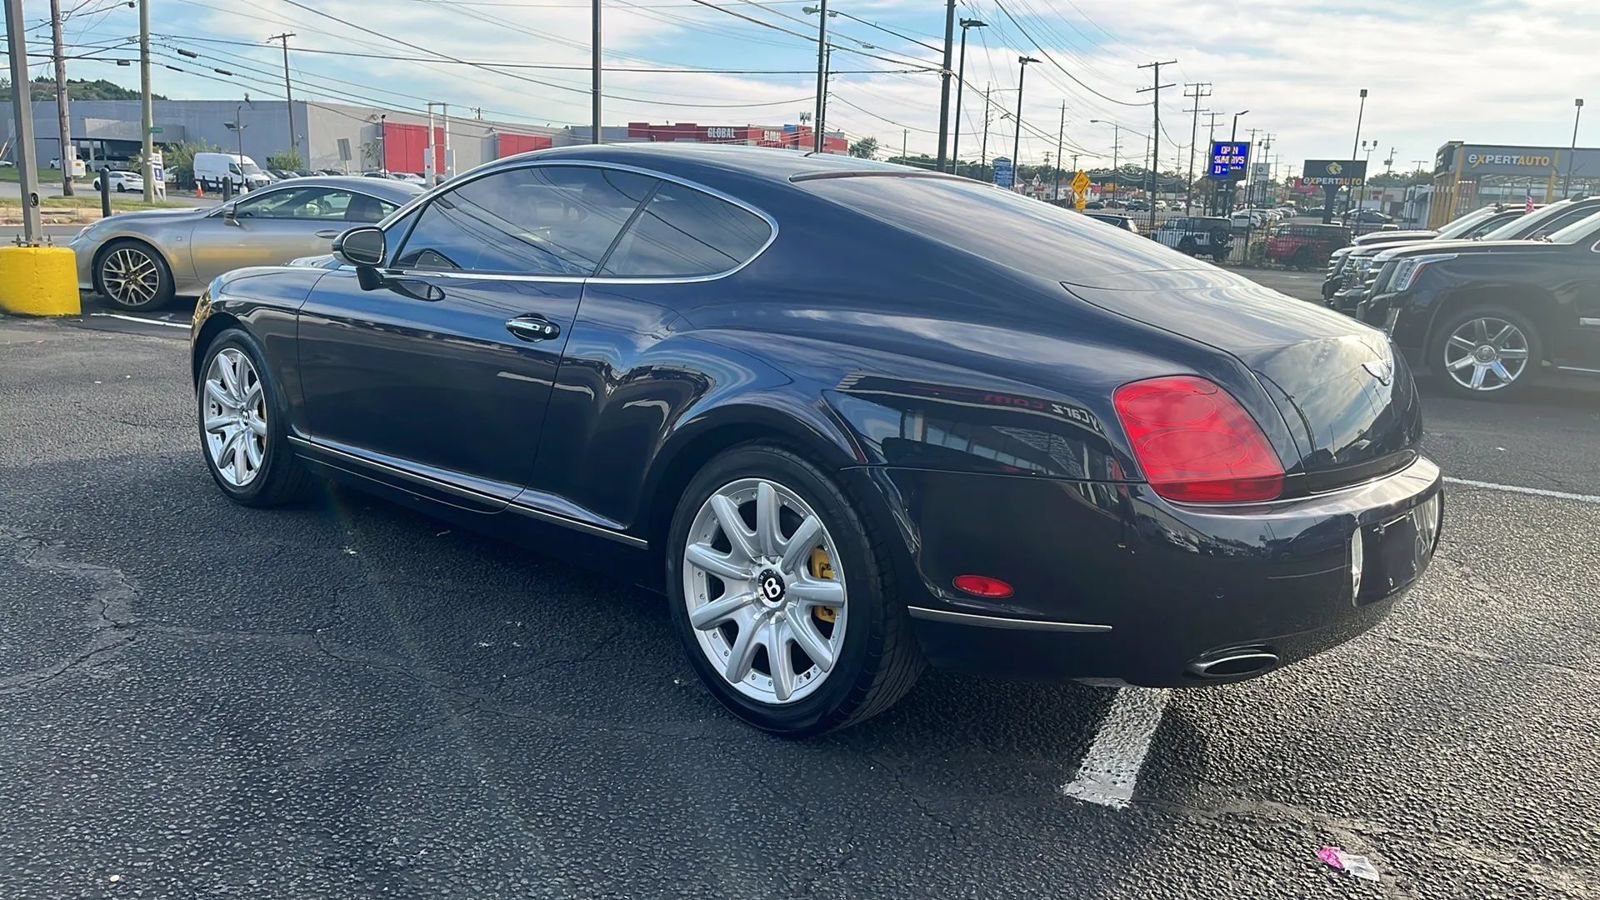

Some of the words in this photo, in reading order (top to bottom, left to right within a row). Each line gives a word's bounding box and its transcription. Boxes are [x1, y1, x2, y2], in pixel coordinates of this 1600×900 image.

[707, 127, 736, 138] GLOBAL
[1221, 146, 1239, 154] OPN
[764, 577, 781, 598] B
